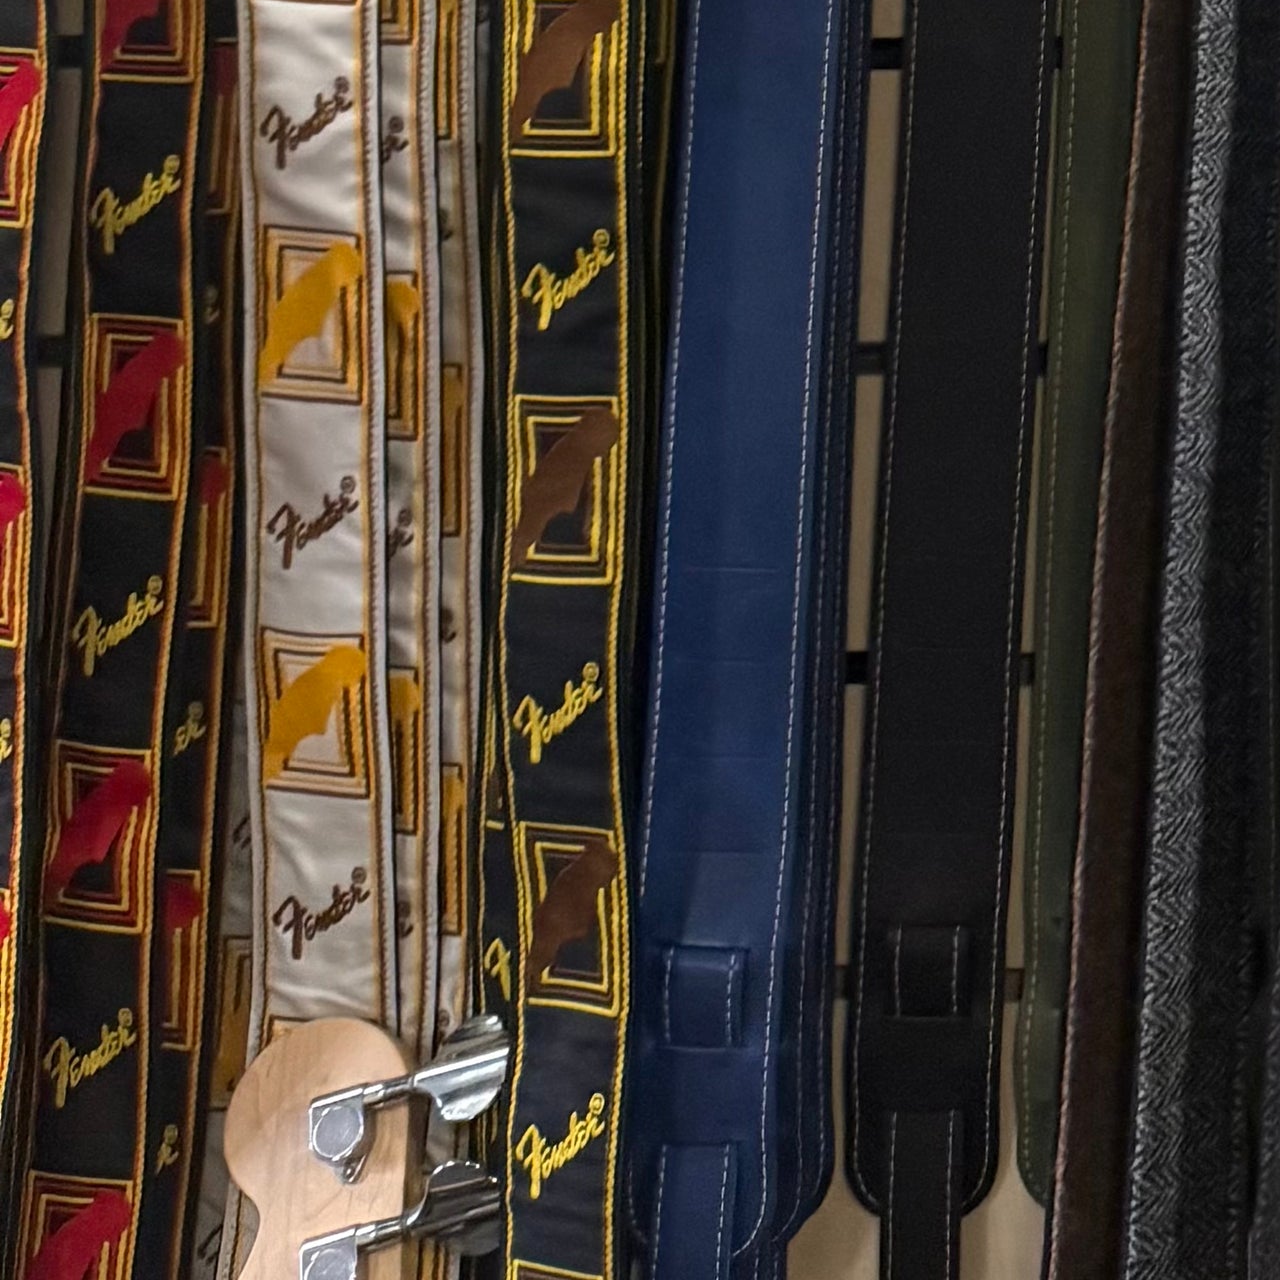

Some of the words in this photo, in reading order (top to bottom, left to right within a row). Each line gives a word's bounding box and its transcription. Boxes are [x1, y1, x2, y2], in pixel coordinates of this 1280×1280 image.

[259, 87, 352, 170] Fender
[91, 165, 181, 254] Fender
[521, 241, 616, 330] Fender
[267, 489, 359, 570] Fender
[72, 587, 165, 676] Fender
[513, 676, 602, 764] Fender
[272, 880, 371, 959] Fender
[43, 1023, 136, 1107] Fender
[516, 1105, 606, 1199] Fender
